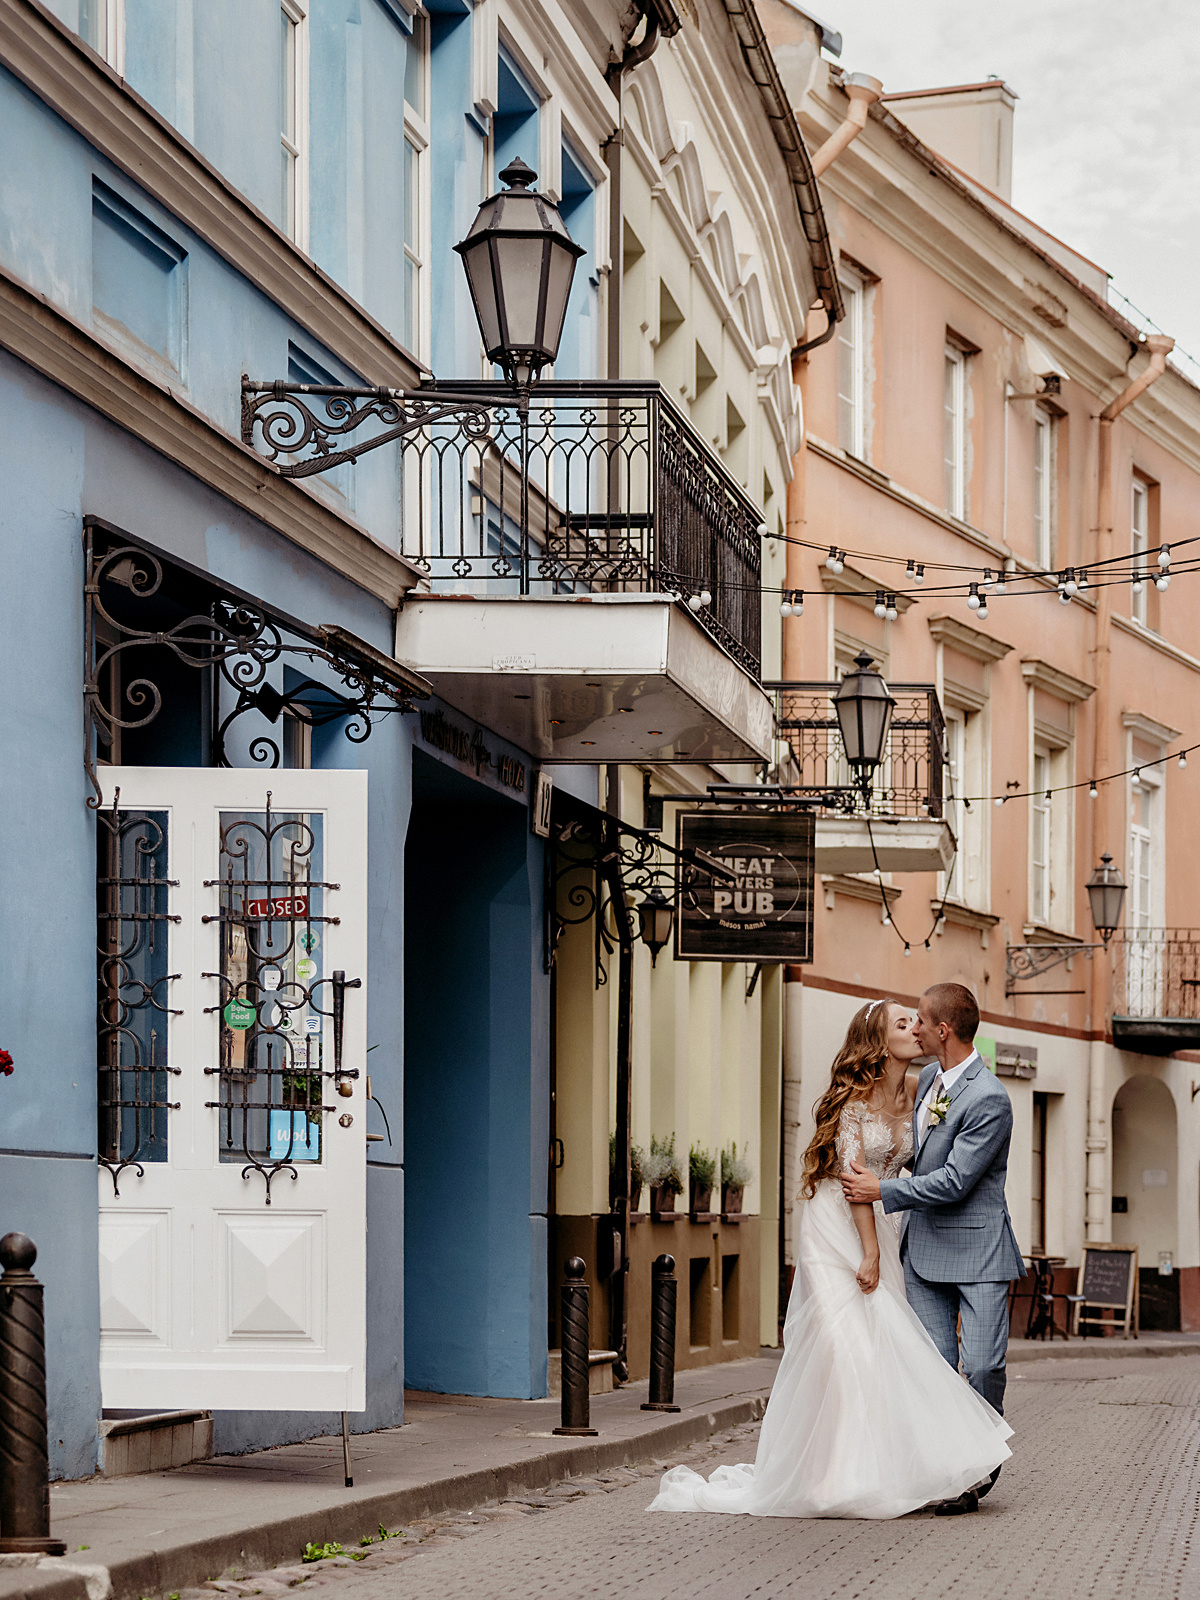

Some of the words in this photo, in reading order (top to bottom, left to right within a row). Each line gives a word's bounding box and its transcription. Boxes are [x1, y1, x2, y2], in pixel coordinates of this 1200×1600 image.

[541, 782, 550, 828] 12
[714, 857, 775, 875] MEAT
[714, 877, 774, 889] VERS
[247, 899, 306, 916] CLOSED
[713, 891, 775, 915] PUB
[744, 918, 766, 930] namai
[231, 1012, 250, 1020] Food
